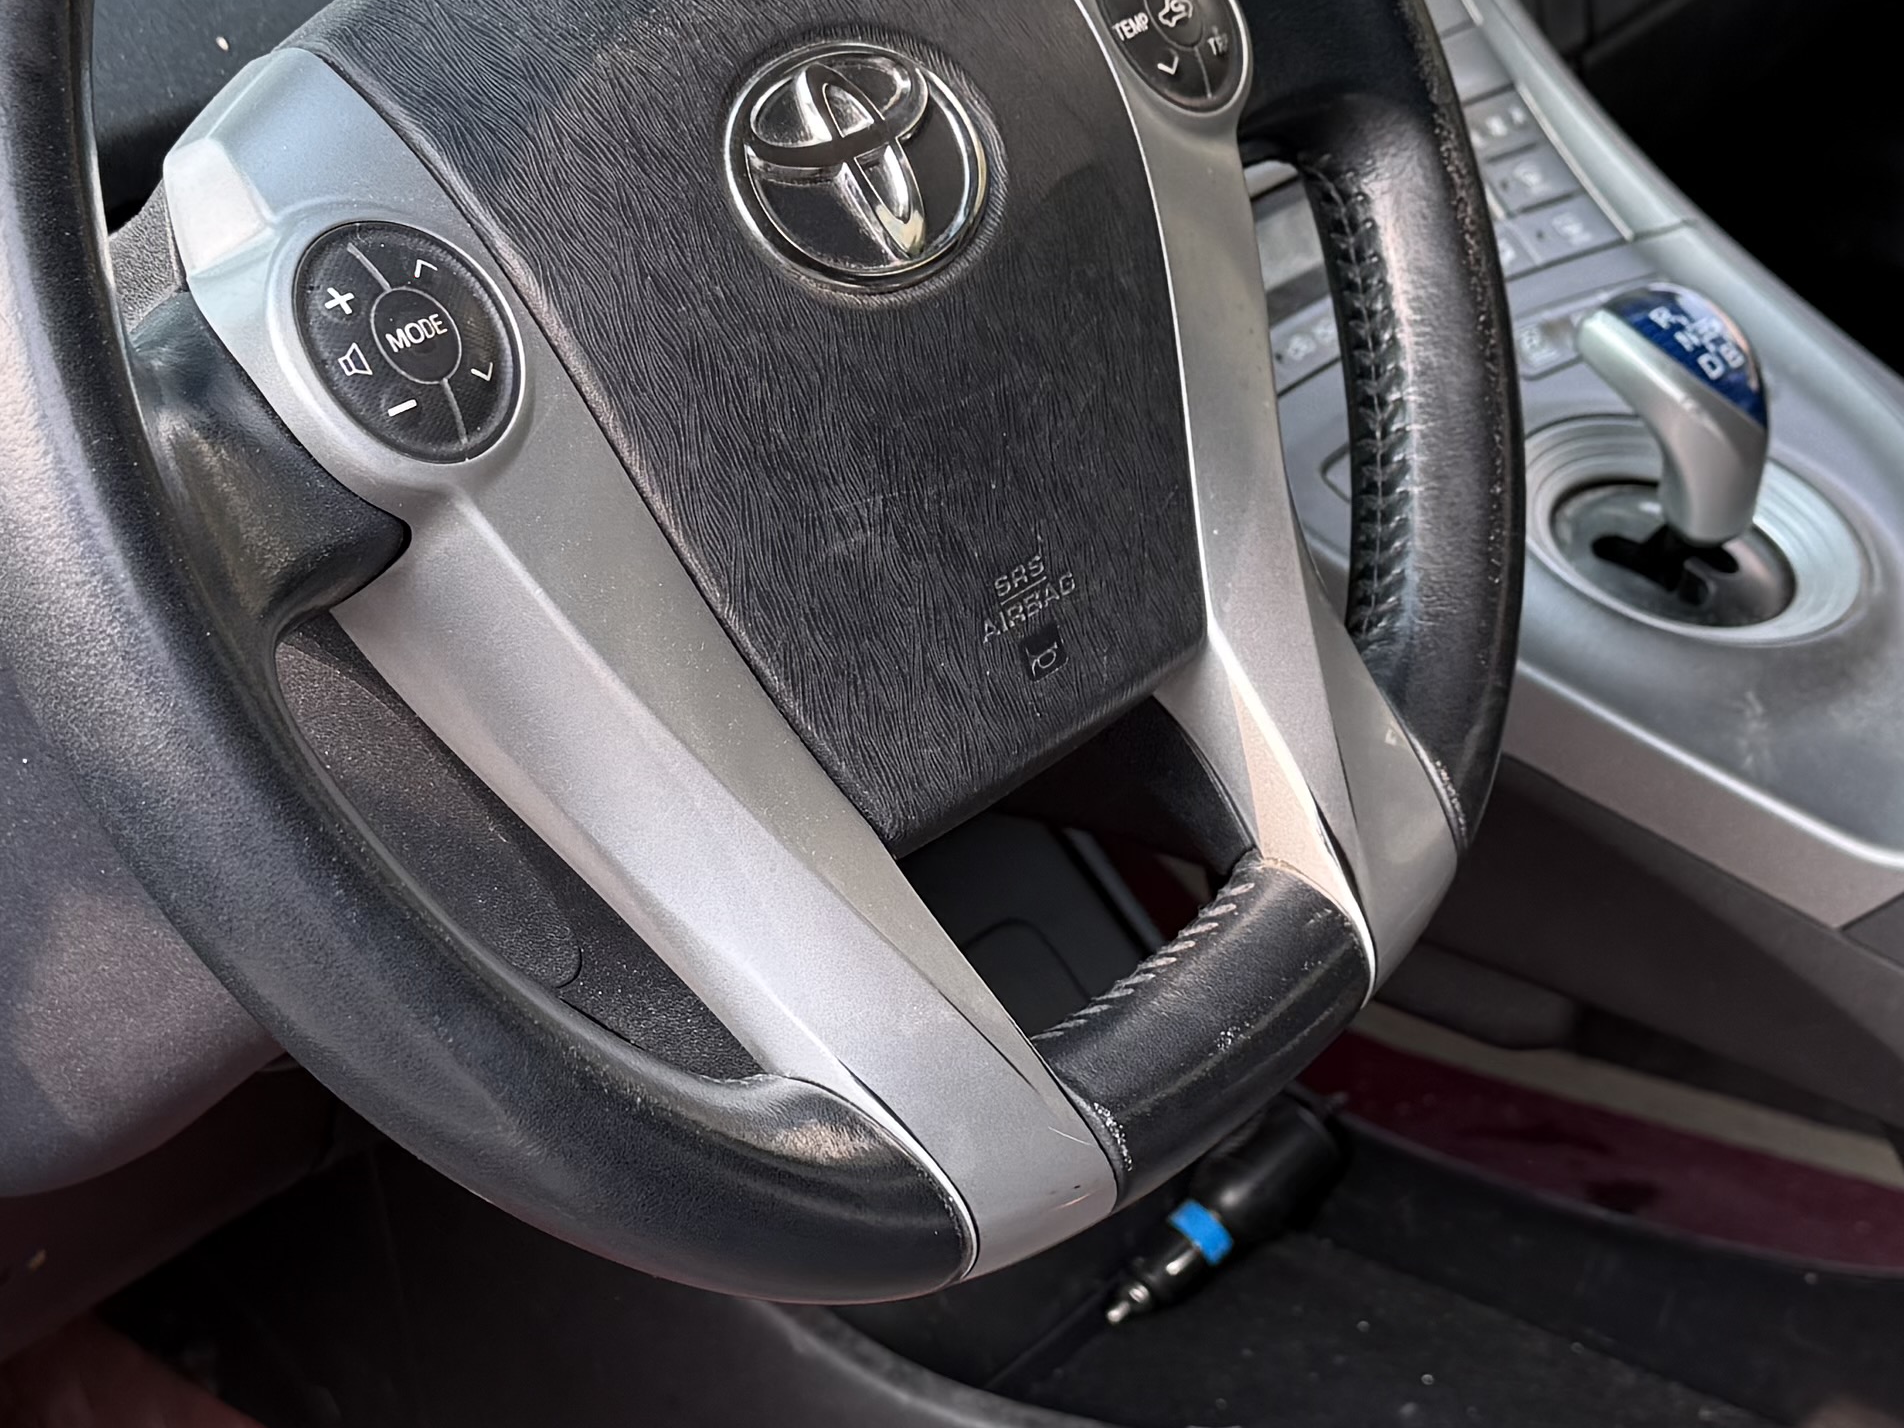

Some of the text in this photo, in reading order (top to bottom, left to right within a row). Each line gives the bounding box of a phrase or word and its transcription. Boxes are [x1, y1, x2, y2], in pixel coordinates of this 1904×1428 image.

[1112, 12, 1149, 41] TEMP
[385, 313, 448, 353] MODE
[1697, 352, 1725, 381] D
[994, 554, 1045, 598] SRS
[983, 572, 1077, 644] AIRBAG
